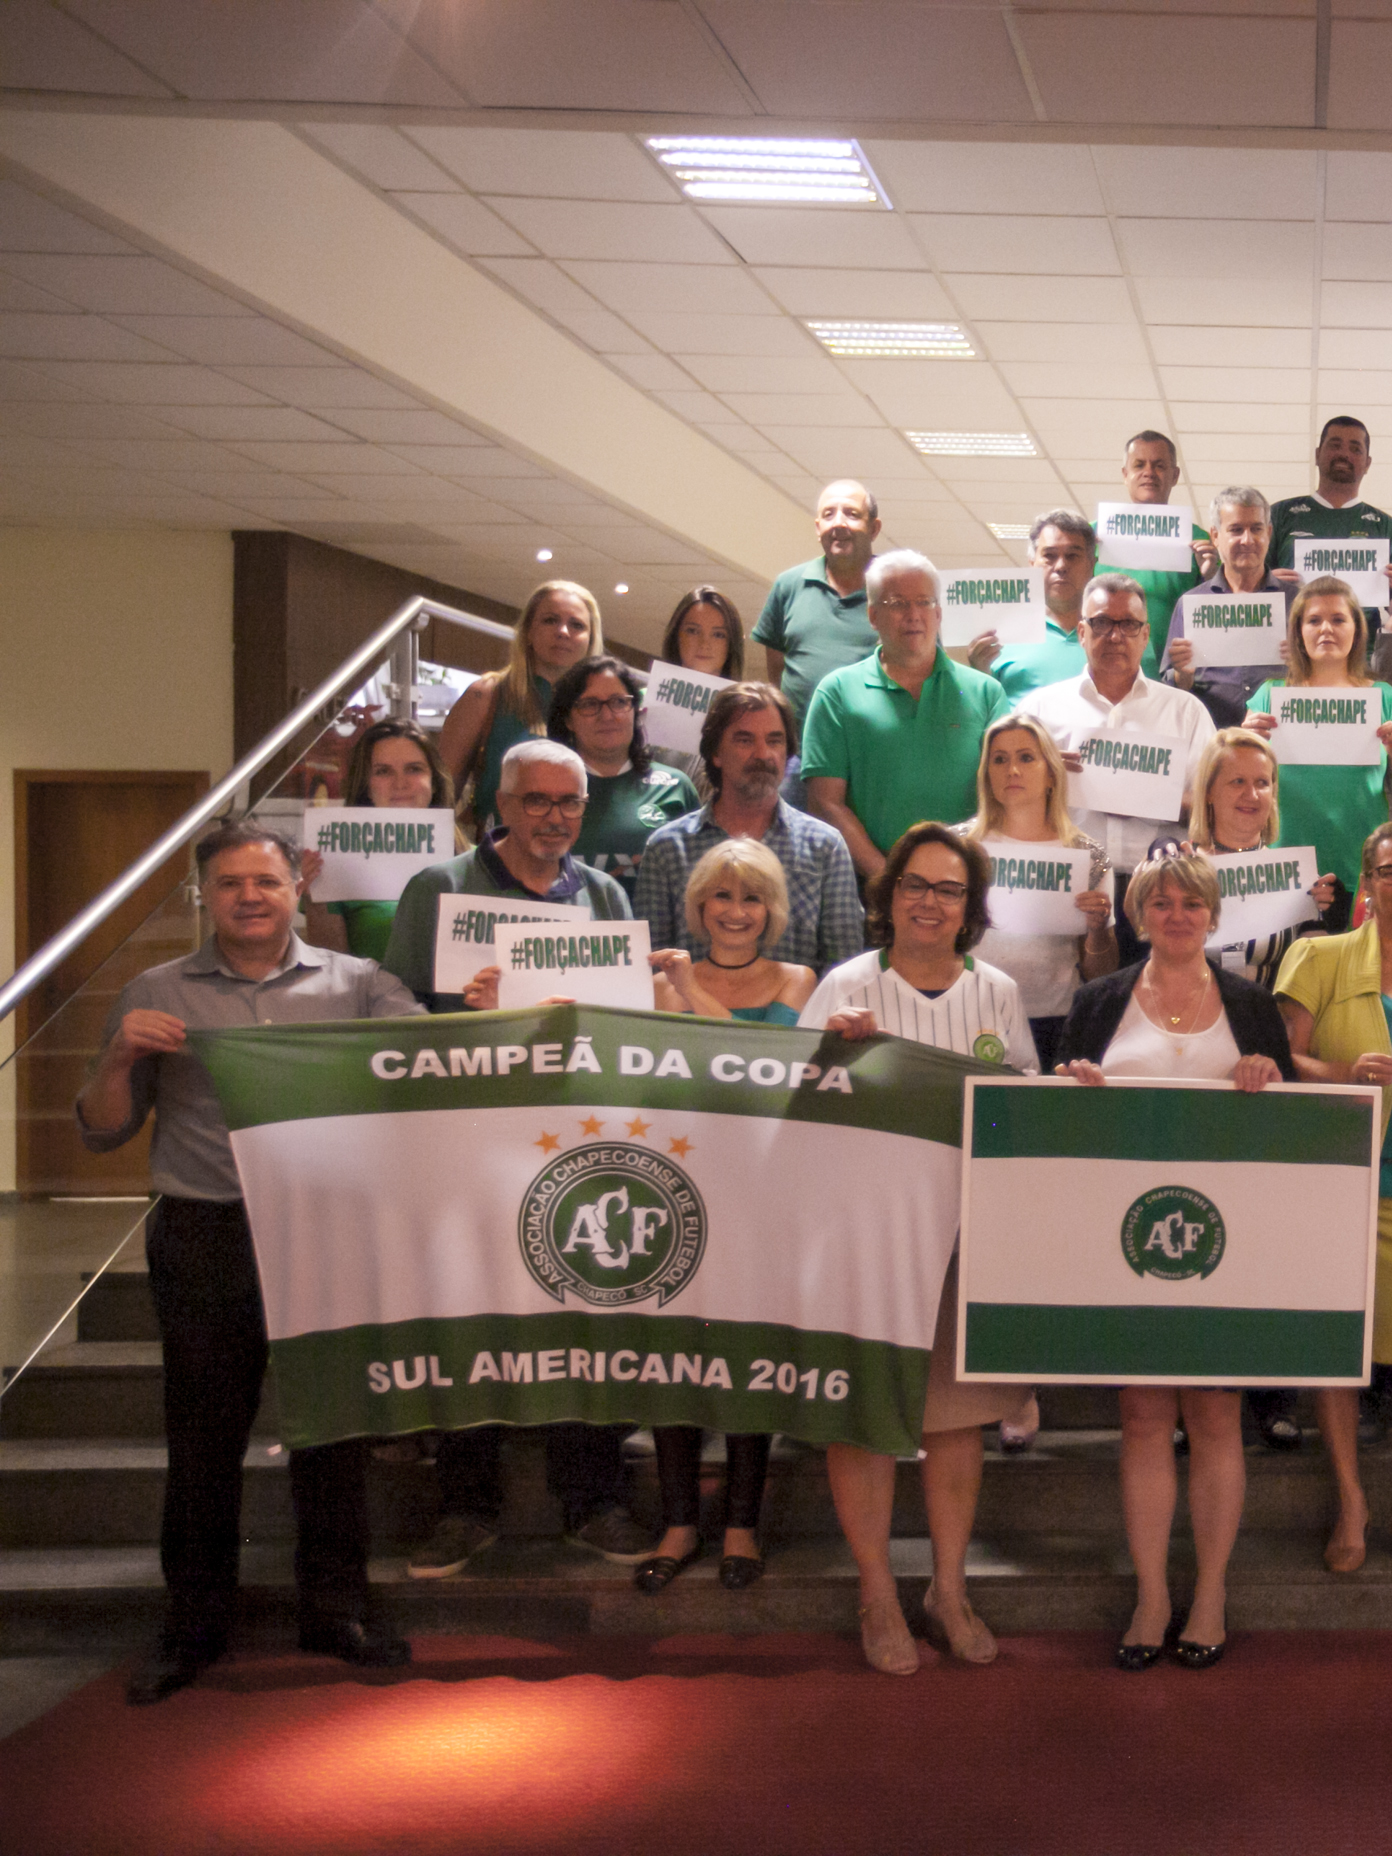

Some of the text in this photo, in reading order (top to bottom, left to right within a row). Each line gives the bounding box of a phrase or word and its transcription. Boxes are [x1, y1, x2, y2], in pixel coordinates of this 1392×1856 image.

[1106, 514, 1180, 540] #FORÇACHAPE
[1303, 549, 1377, 575] #FORÇACHAPE
[946, 579, 1031, 608] #FORÇACHAPE
[1192, 604, 1272, 632] #FORÇACHAPE
[656, 678, 719, 717] #FORÇA
[1280, 698, 1367, 728] #FORÇACHAPE
[1078, 738, 1172, 775] #FORÇACHAPE
[318, 822, 435, 859] #FORÇACHAPE
[989, 857, 1072, 894] ORÇACHAPE
[1217, 860, 1301, 902] ORÇACHAPE
[511, 934, 632, 975] #FORÇACHAPE
[370, 1036, 853, 1094] CAMPEÃ DA COPA
[527, 1150, 699, 1286] ASSOCIAÇÃO CHAPECOENSE DE FUTEBOL
[368, 1348, 850, 1401] SUL AMERICANA 2016
